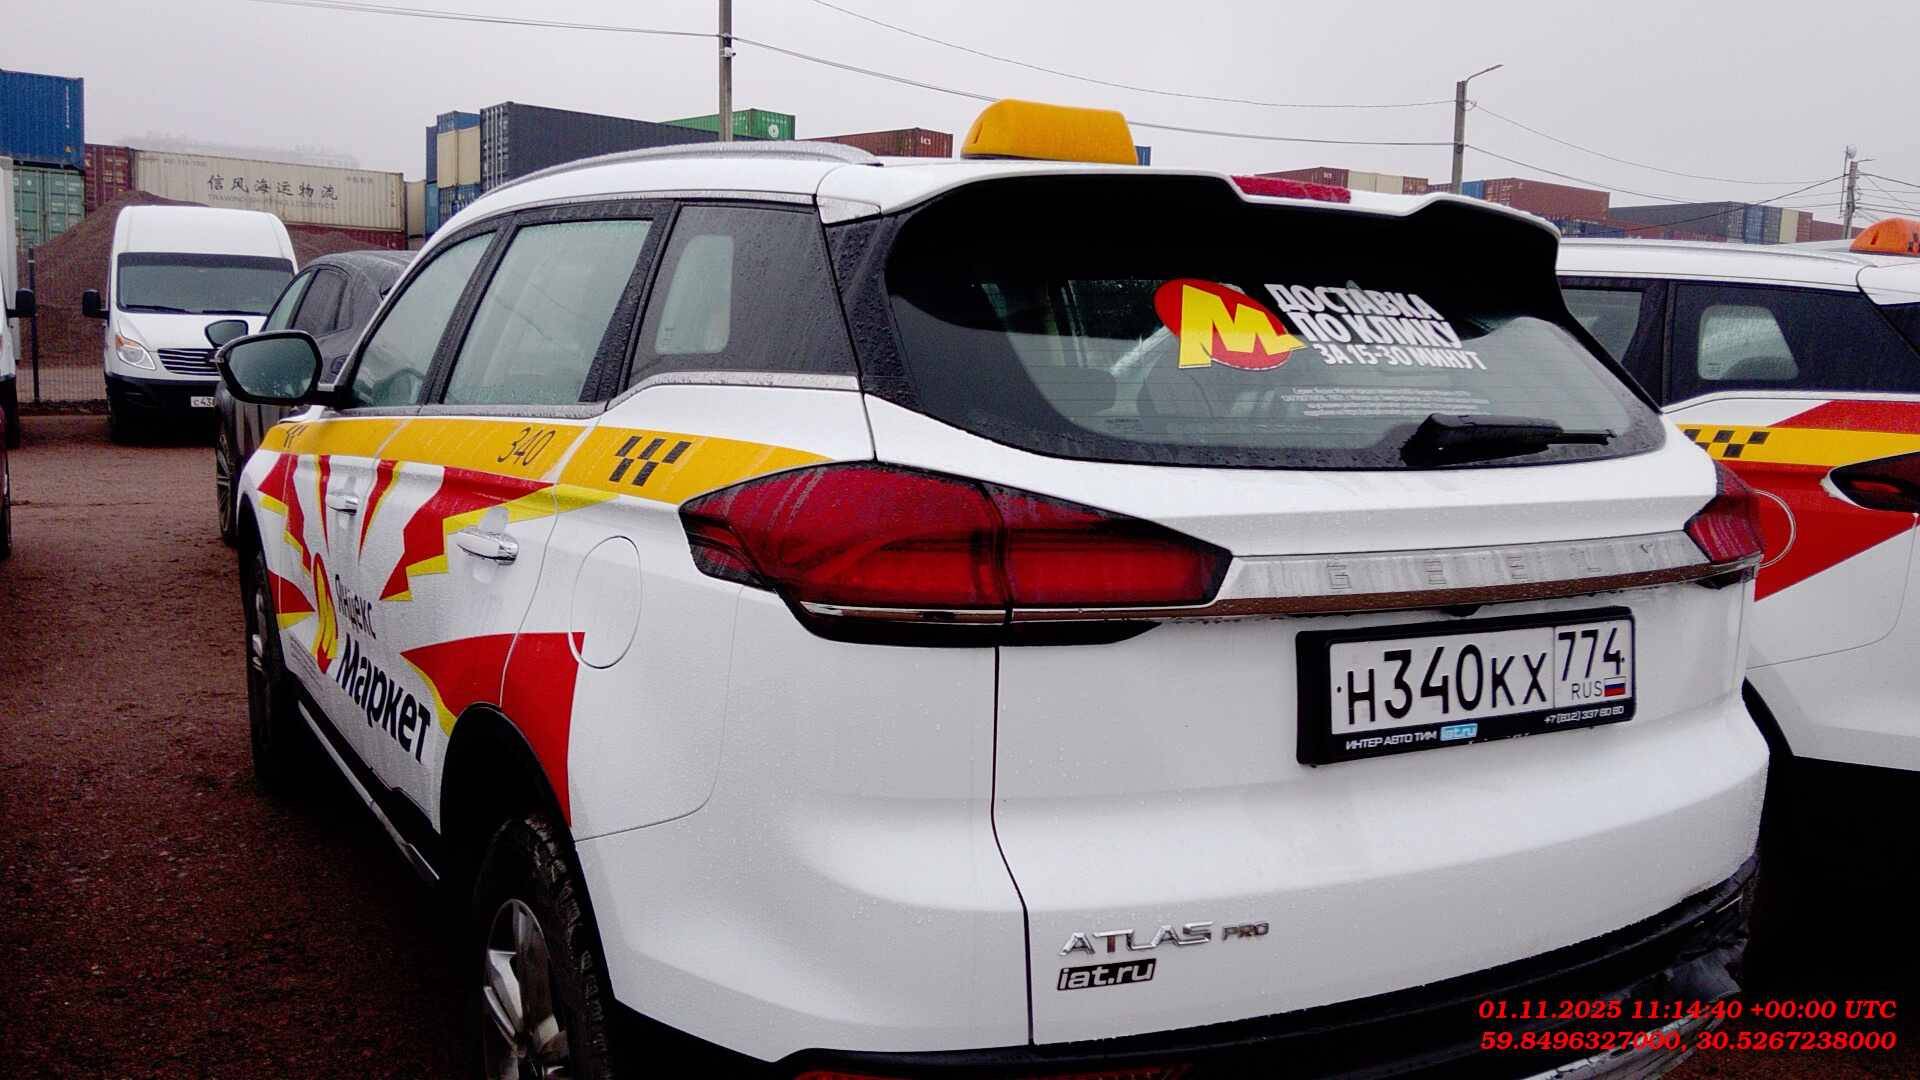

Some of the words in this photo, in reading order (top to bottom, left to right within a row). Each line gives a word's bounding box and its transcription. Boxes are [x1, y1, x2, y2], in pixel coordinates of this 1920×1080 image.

[207, 175, 338, 201] 信风海运物流
[1264, 283, 1444, 320] ДОСТАВКА
[1287, 312, 1352, 343] ПО
[1342, 314, 1463, 349] КЛИКУ
[1313, 343, 1354, 365] ЗА
[1350, 344, 1412, 366] 15-30
[1408, 347, 1488, 370] МИНУТ
[497, 427, 557, 466] 340
[1557, 627, 1622, 682] 774
[336, 632, 431, 765] Маркет
[1571, 681, 1603, 700] RUS
[1345, 737, 1383, 750] ИНТЕР
[1383, 733, 1414, 746] АВТО
[1414, 730, 1437, 742] ТИМ
[1059, 921, 1214, 956] ATLAS
[1222, 922, 1270, 941] PRO
[1058, 962, 1155, 989] iat.ru
